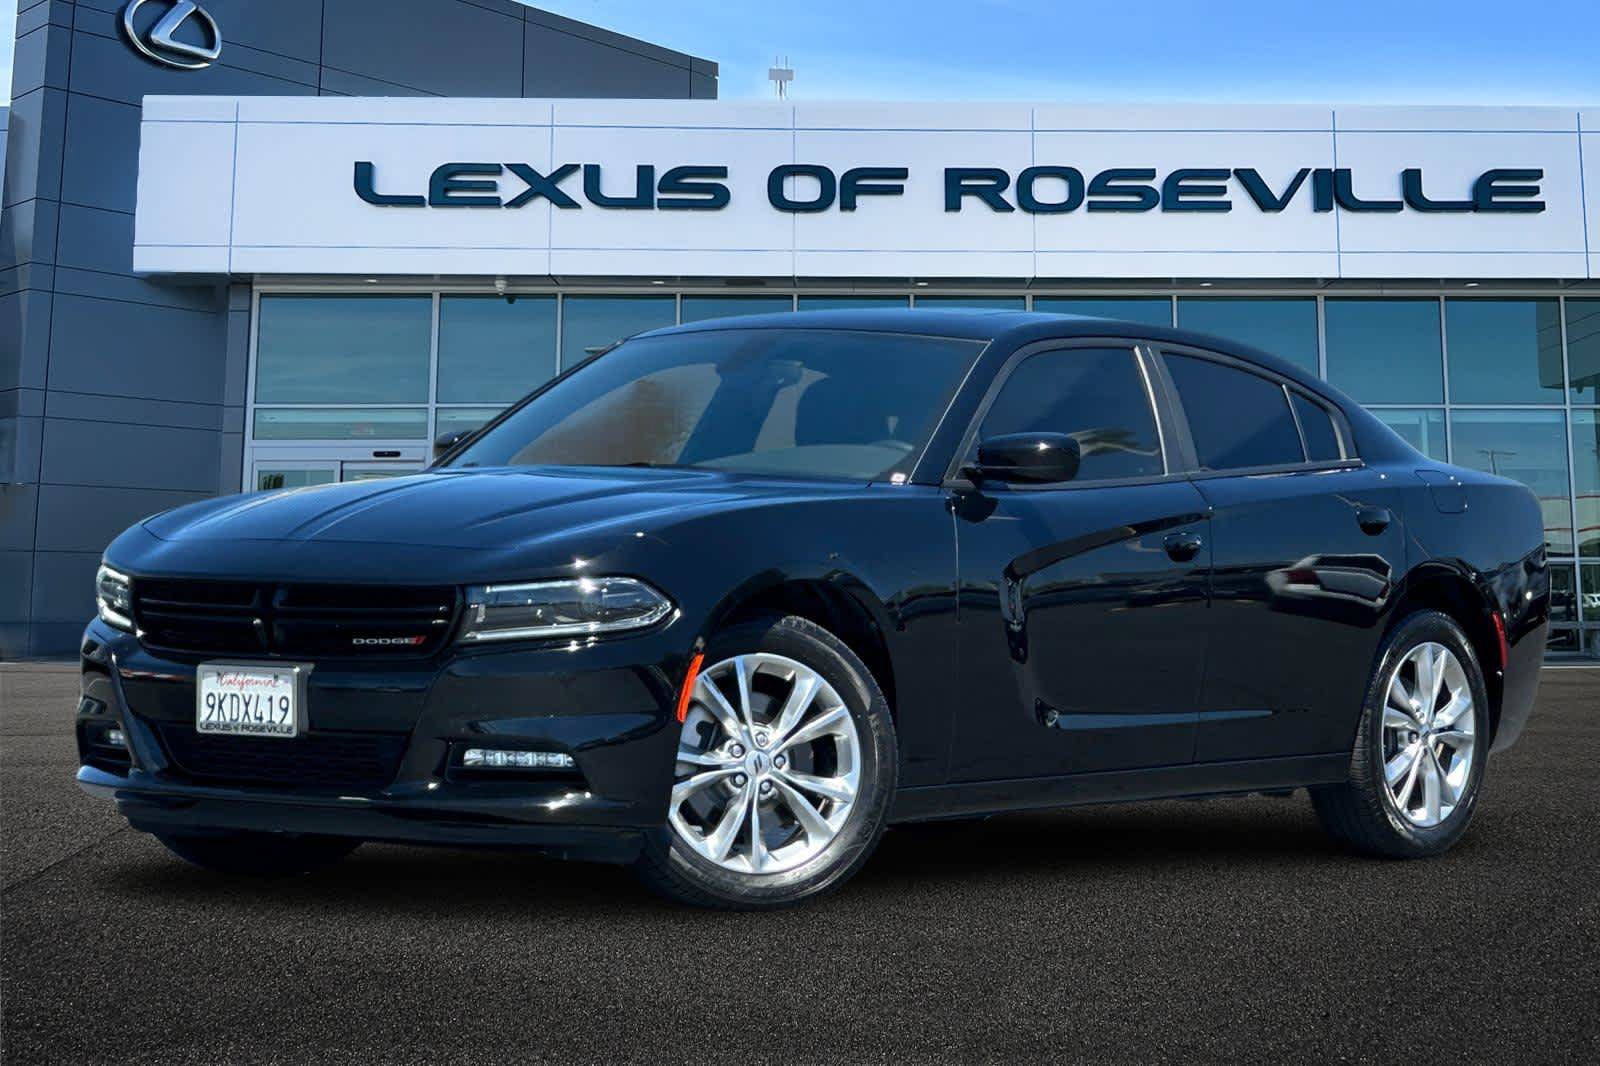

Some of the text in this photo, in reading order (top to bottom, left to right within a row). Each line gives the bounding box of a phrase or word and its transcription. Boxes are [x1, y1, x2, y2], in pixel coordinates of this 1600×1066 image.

[354, 161, 1546, 213] LEXUS OF ROSEVILLE
[219, 672, 279, 691] California
[206, 692, 290, 724] 9KDX419
